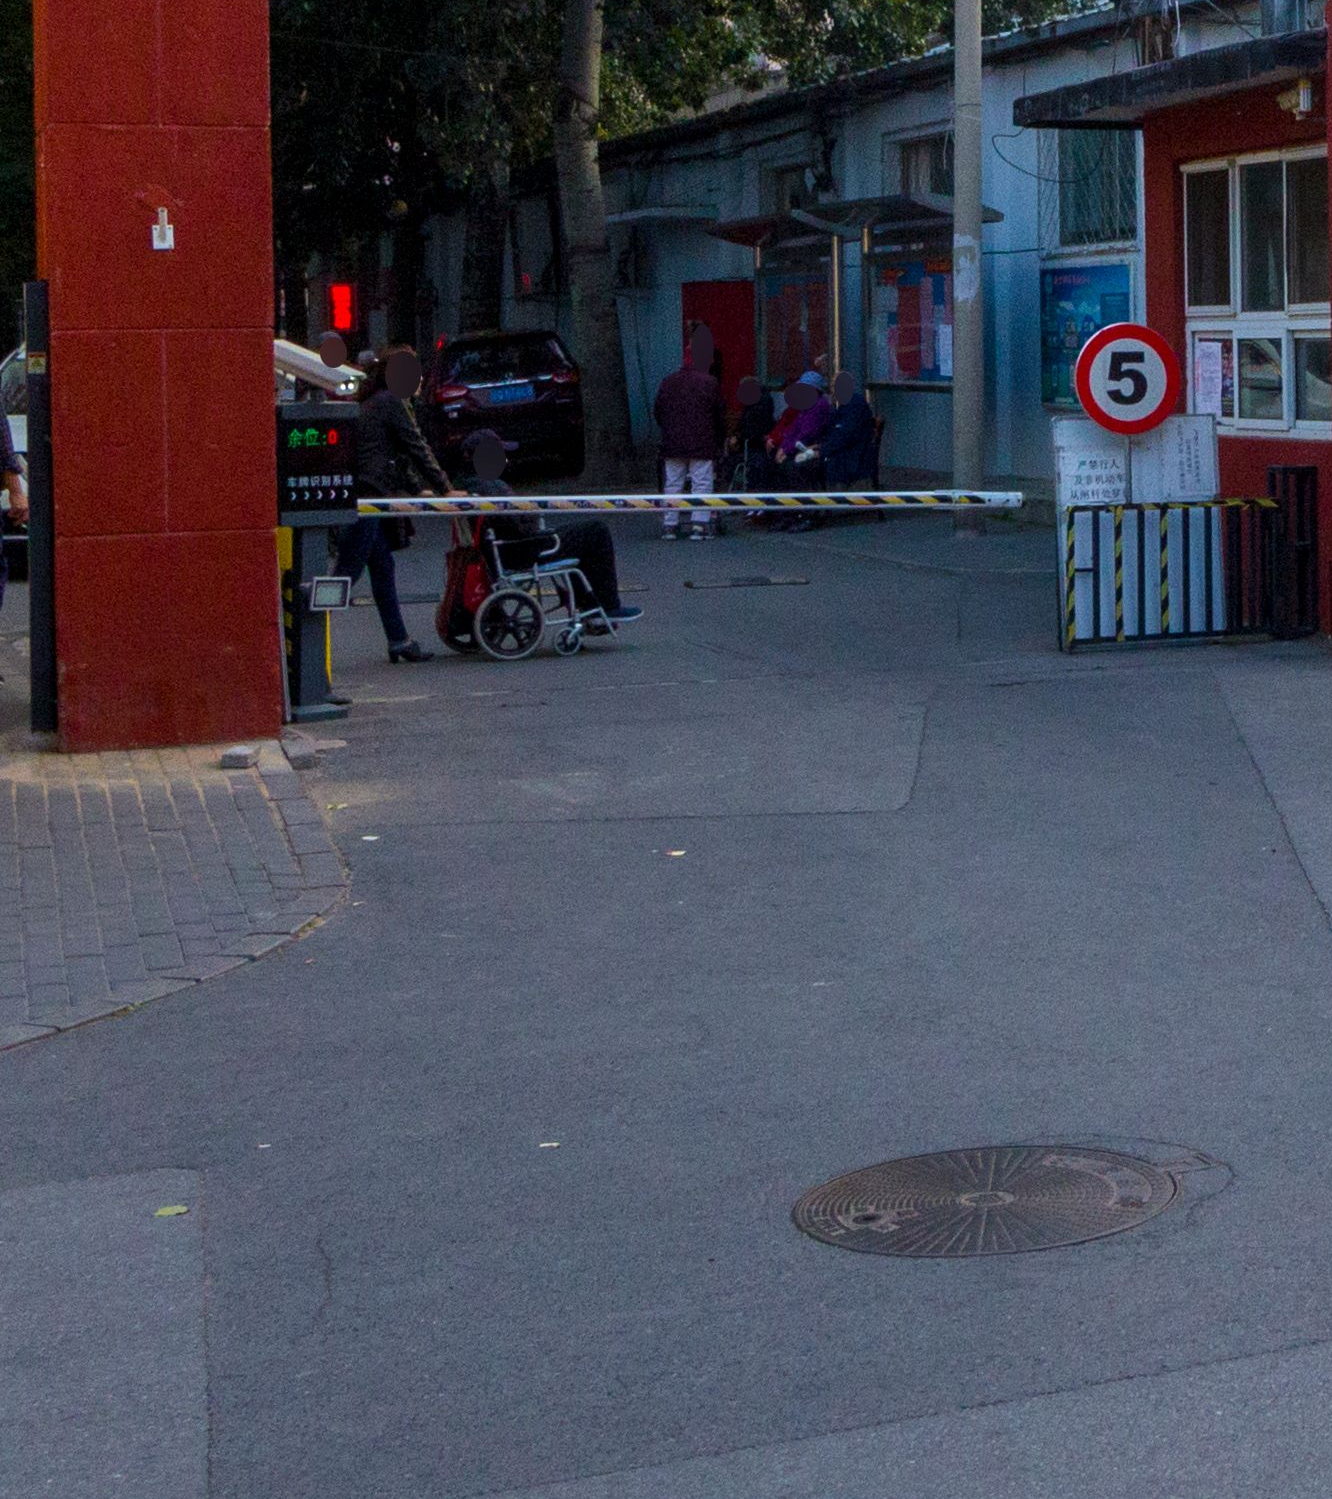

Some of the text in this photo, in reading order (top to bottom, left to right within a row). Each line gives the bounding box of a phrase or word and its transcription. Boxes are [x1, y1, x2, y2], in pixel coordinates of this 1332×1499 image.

[1106, 351, 1149, 406] 5
[1078, 458, 1120, 470] 严禁行人
[287, 474, 353, 488] 车牌识别系统
